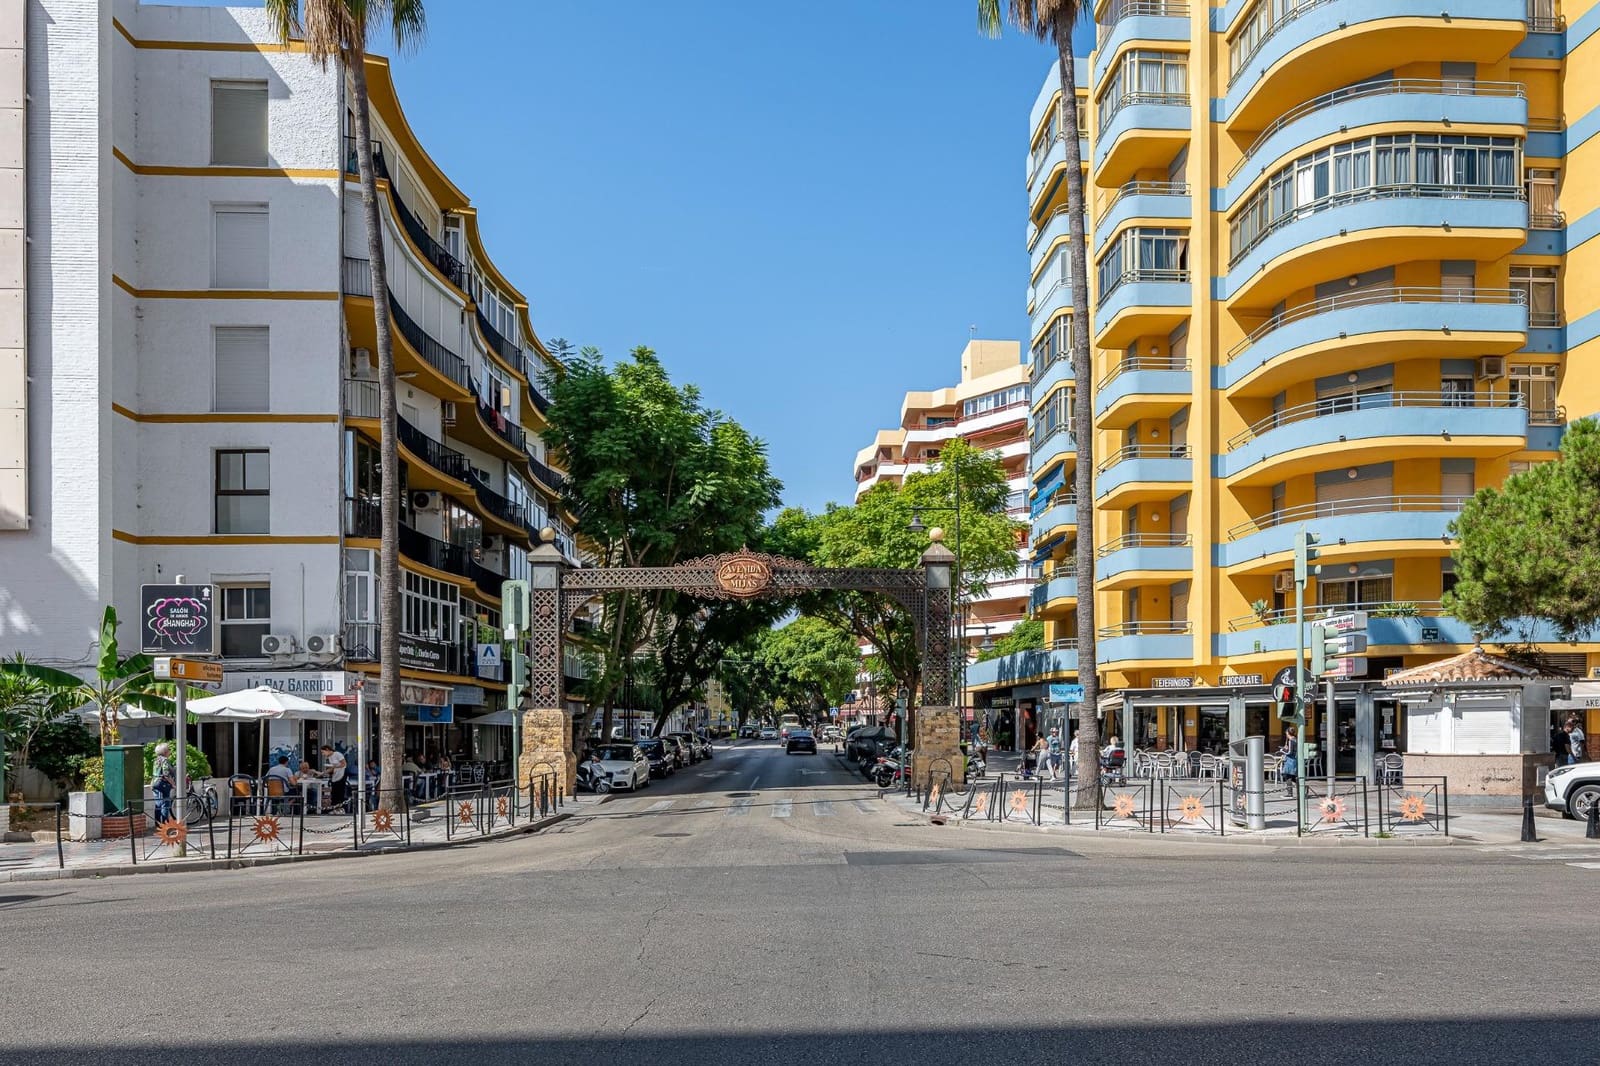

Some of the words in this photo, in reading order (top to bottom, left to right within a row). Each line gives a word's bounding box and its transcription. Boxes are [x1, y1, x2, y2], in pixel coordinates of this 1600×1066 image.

[726, 565, 761, 573] AVENIDA
[731, 580, 757, 589] MIJAS
[163, 619, 195, 628] SHANGHAI
[1222, 675, 1259, 685] CHOCOLATE
[288, 678, 333, 692] GARRIDO
